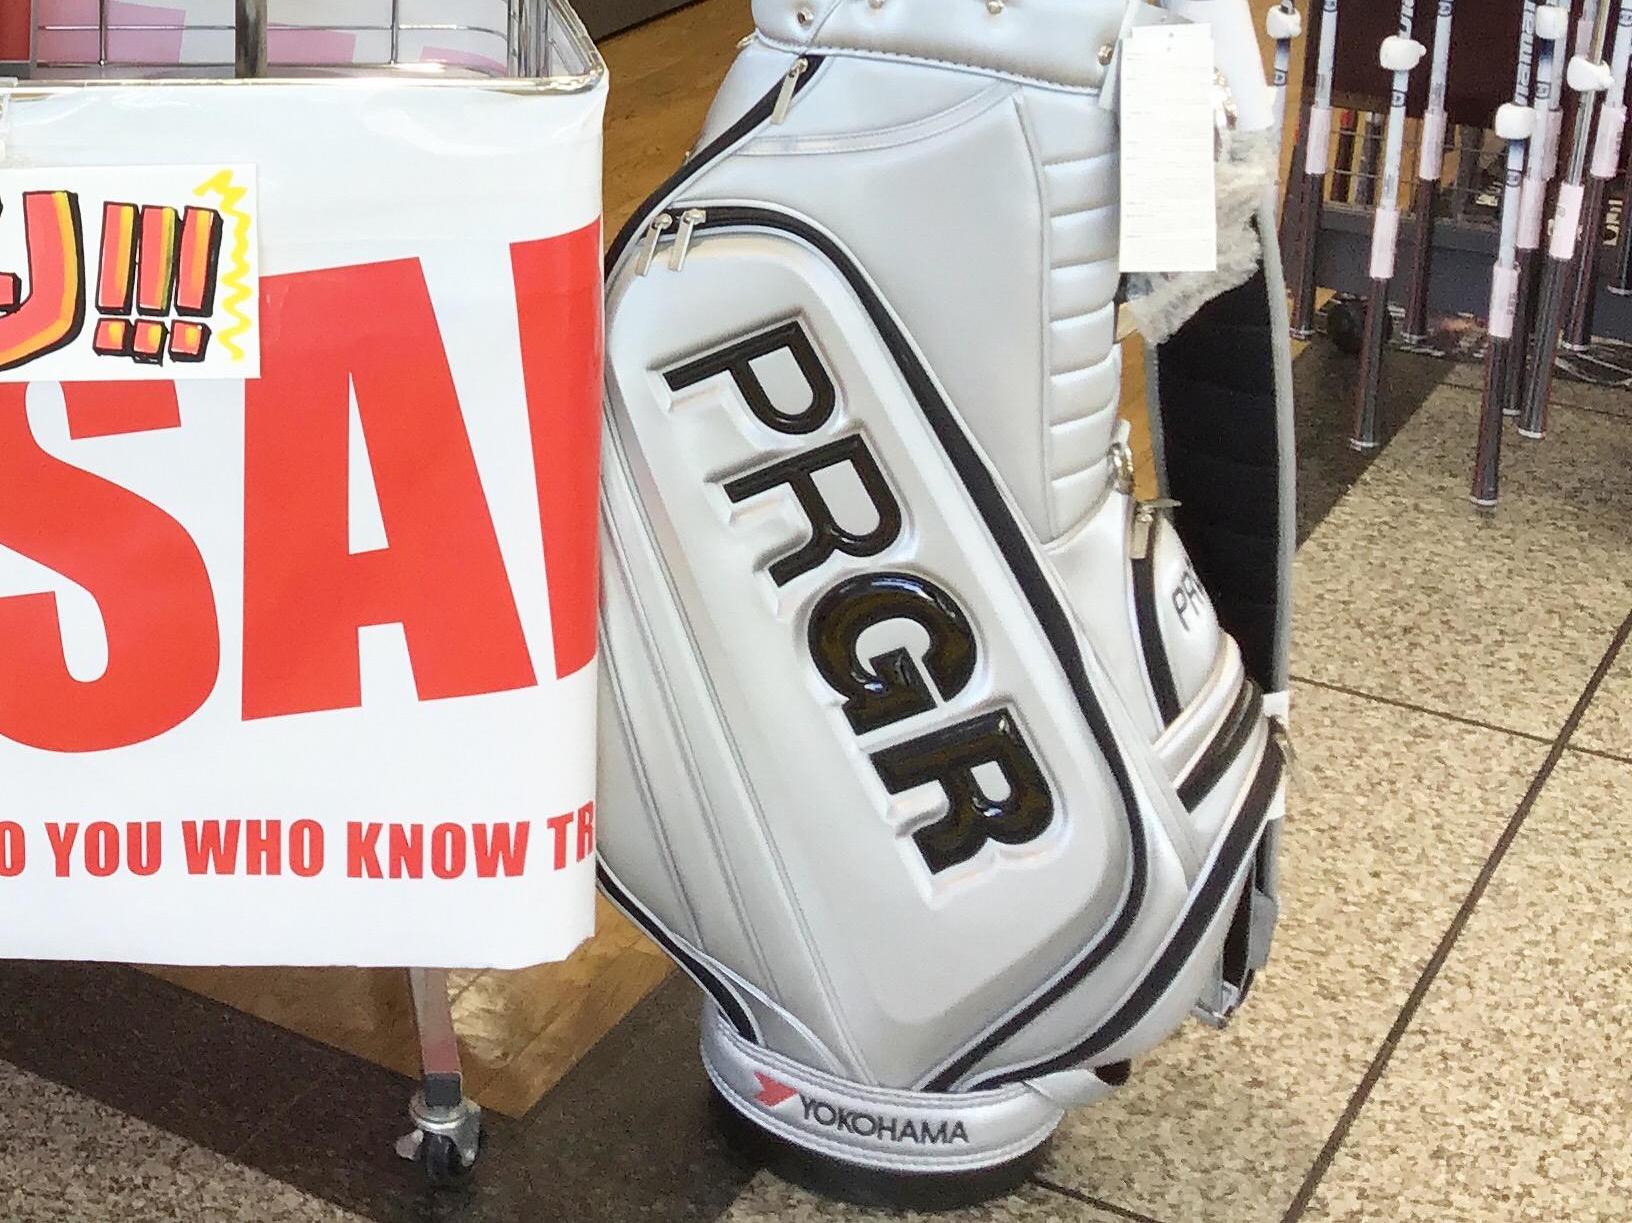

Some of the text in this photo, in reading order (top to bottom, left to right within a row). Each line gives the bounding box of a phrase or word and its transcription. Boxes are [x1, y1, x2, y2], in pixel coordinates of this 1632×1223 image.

[661, 319, 1055, 876] PRGR
[45, 821, 162, 878] YOU
[182, 819, 325, 878] WHO
[347, 821, 530, 880] KNOW
[798, 1092, 970, 1148] YOKOHAMA
